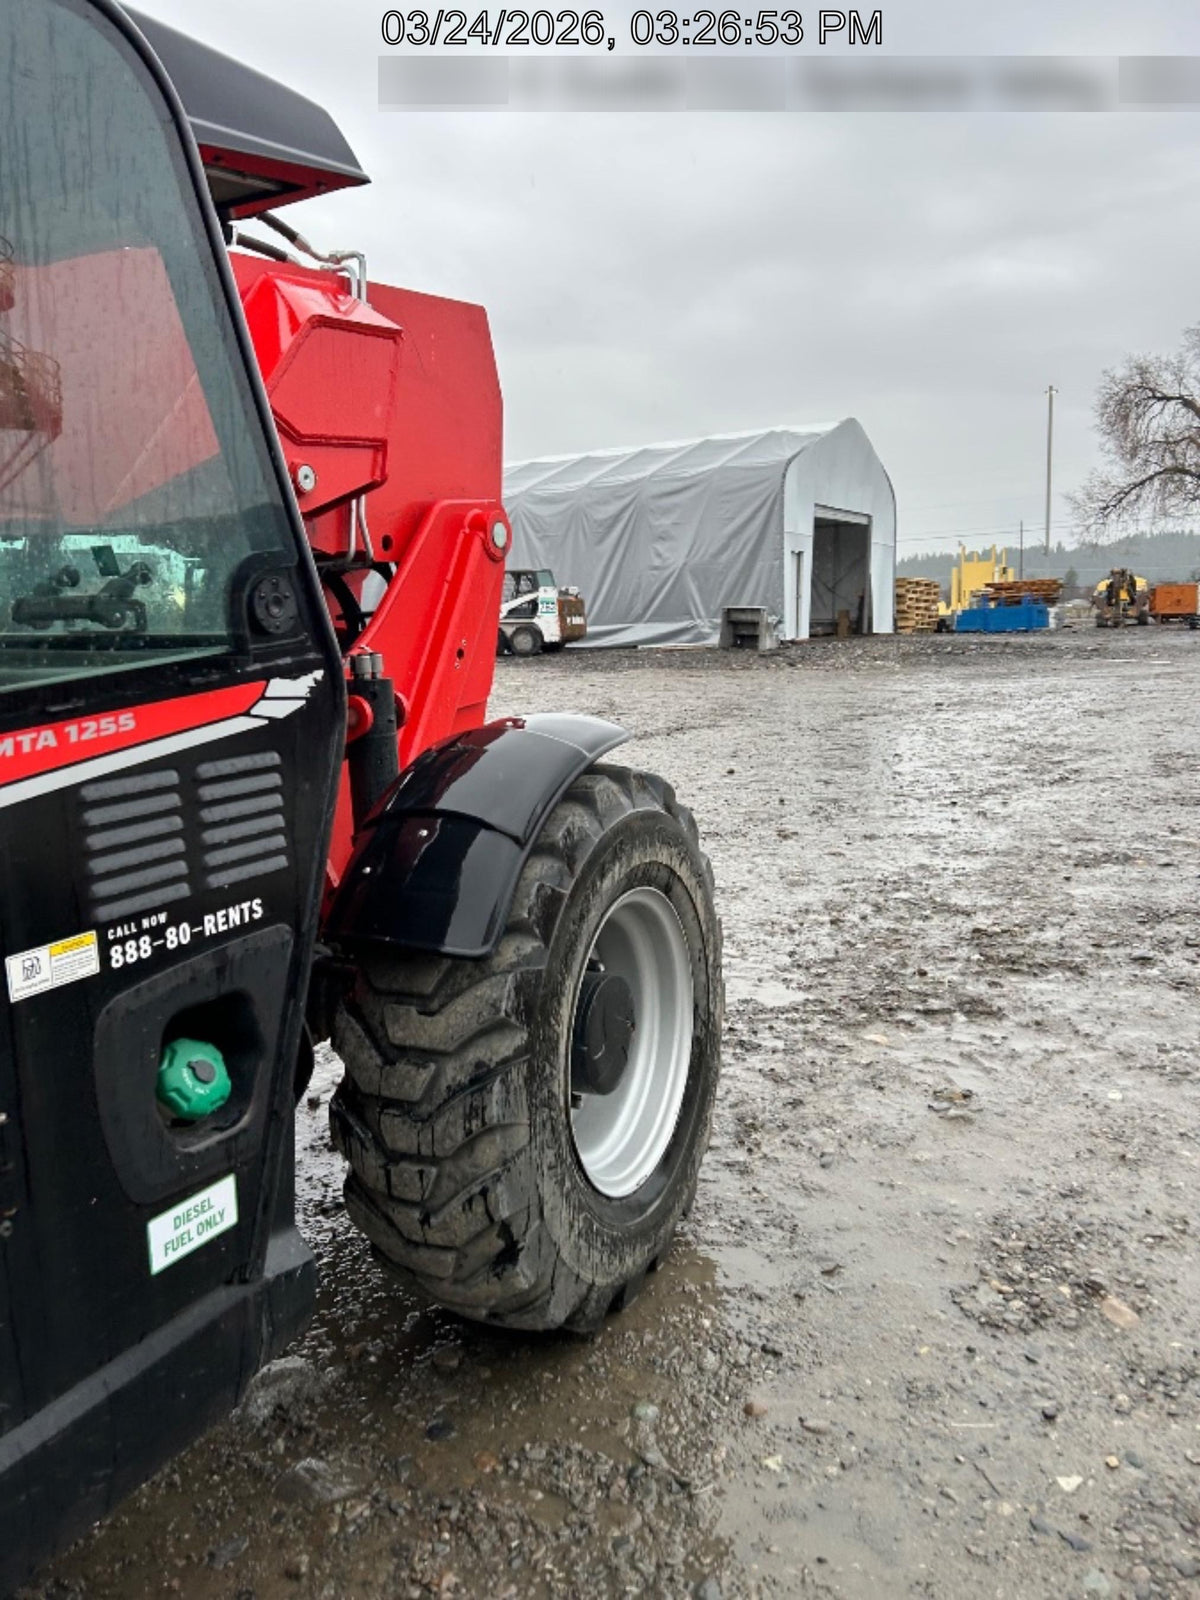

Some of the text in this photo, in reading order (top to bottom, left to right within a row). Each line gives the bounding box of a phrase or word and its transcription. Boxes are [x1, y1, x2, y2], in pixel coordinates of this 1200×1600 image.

[64, 712, 136, 743] 1255
[107, 911, 168, 940] CALL NOW
[109, 898, 263, 969] 888-80-RENTS
[173, 1197, 214, 1230] DIESEL
[164, 1208, 225, 1257] FUEL ONLY
